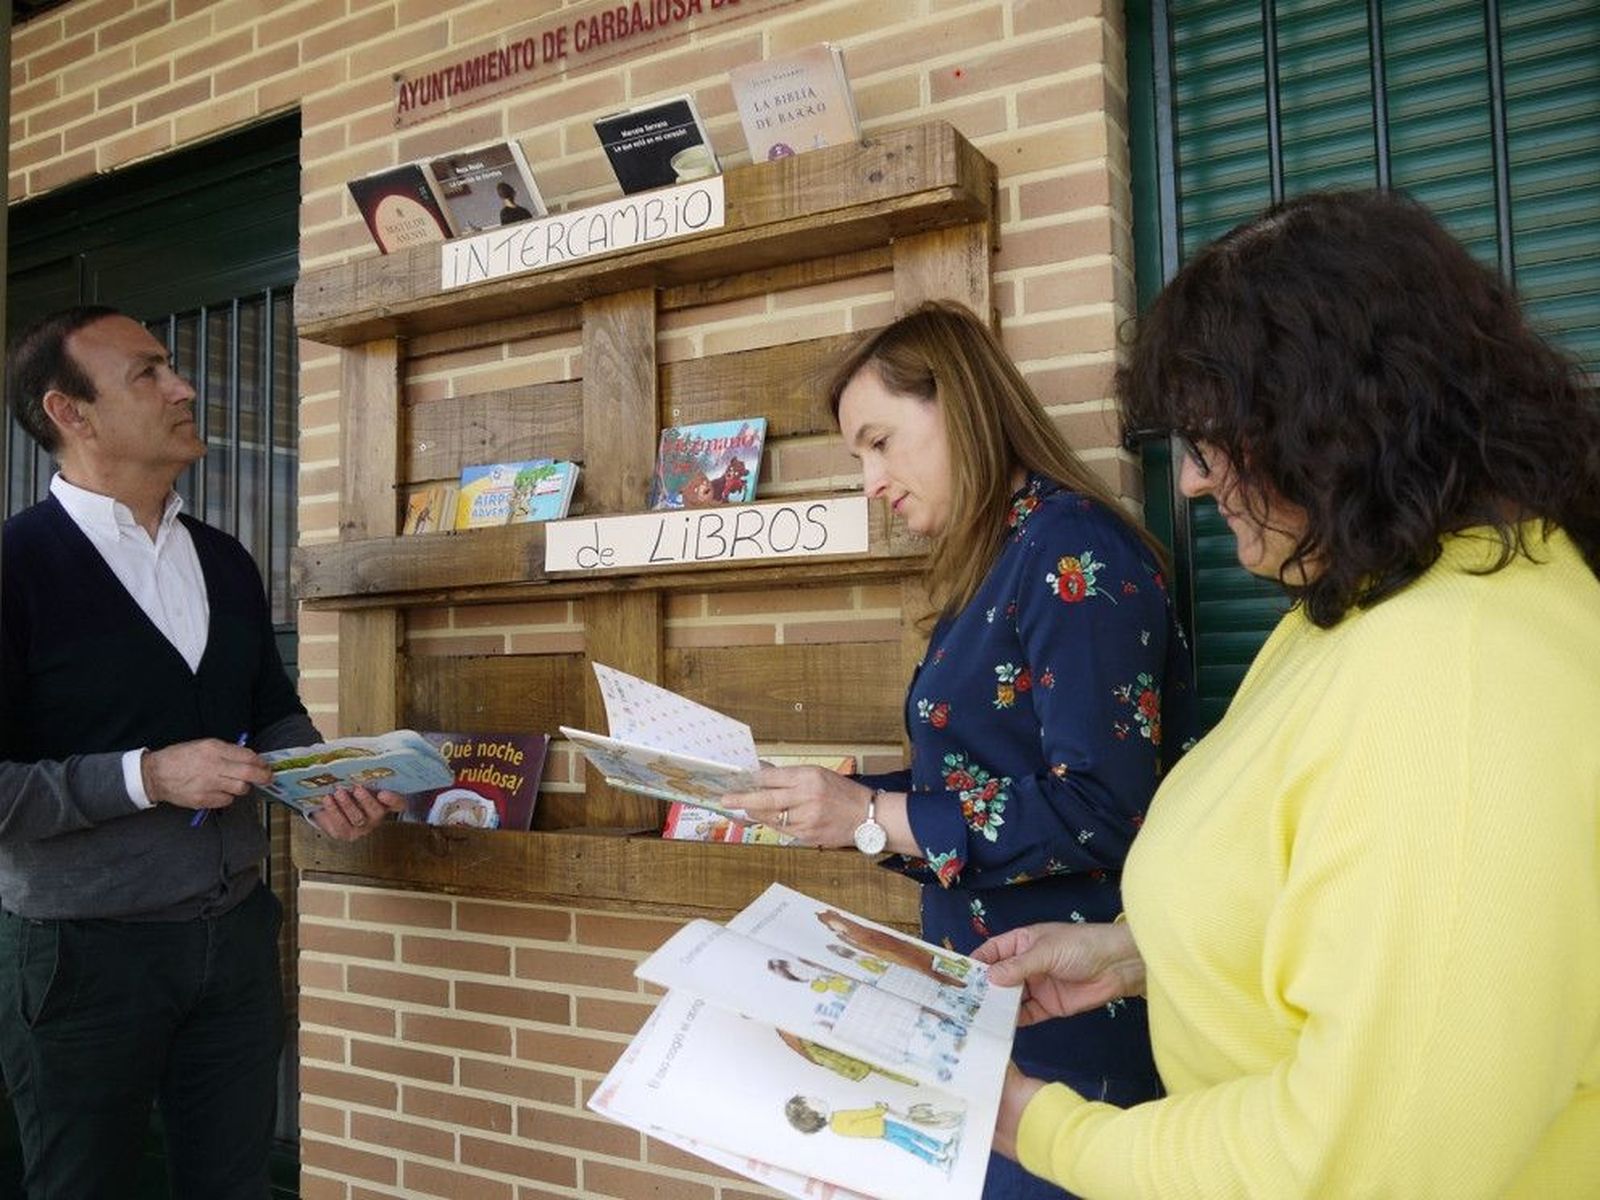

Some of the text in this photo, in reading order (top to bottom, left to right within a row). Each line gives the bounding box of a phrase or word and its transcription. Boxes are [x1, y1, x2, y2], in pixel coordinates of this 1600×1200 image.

[398, 37, 535, 114] AYUNTAMIENTO
[543, 26, 567, 63] DE
[754, 86, 818, 112] LA BIBLIA
[756, 102, 826, 130] DE BARRO
[576, 522, 615, 568] de
[440, 739, 524, 766] Qué noche
[459, 763, 524, 796] ruidosa!
